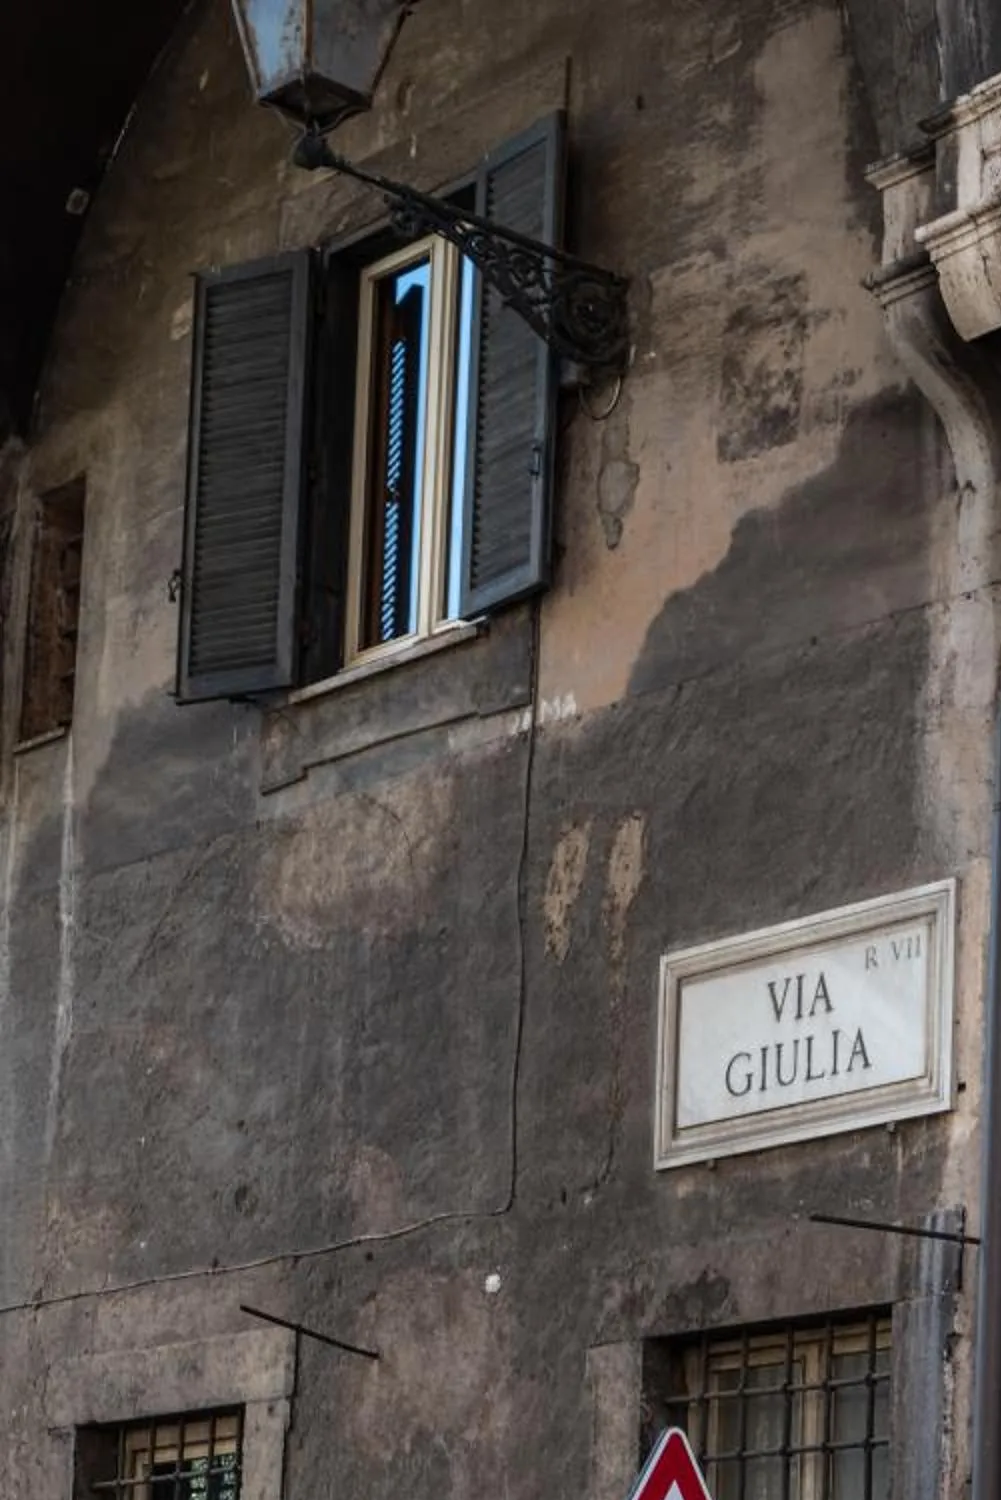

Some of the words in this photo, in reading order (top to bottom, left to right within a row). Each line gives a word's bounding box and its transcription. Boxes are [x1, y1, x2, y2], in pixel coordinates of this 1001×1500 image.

[864, 946, 879, 970] R
[890, 934, 922, 961] VII
[767, 971, 835, 1024] VIA
[724, 1026, 872, 1098] GIULIA
